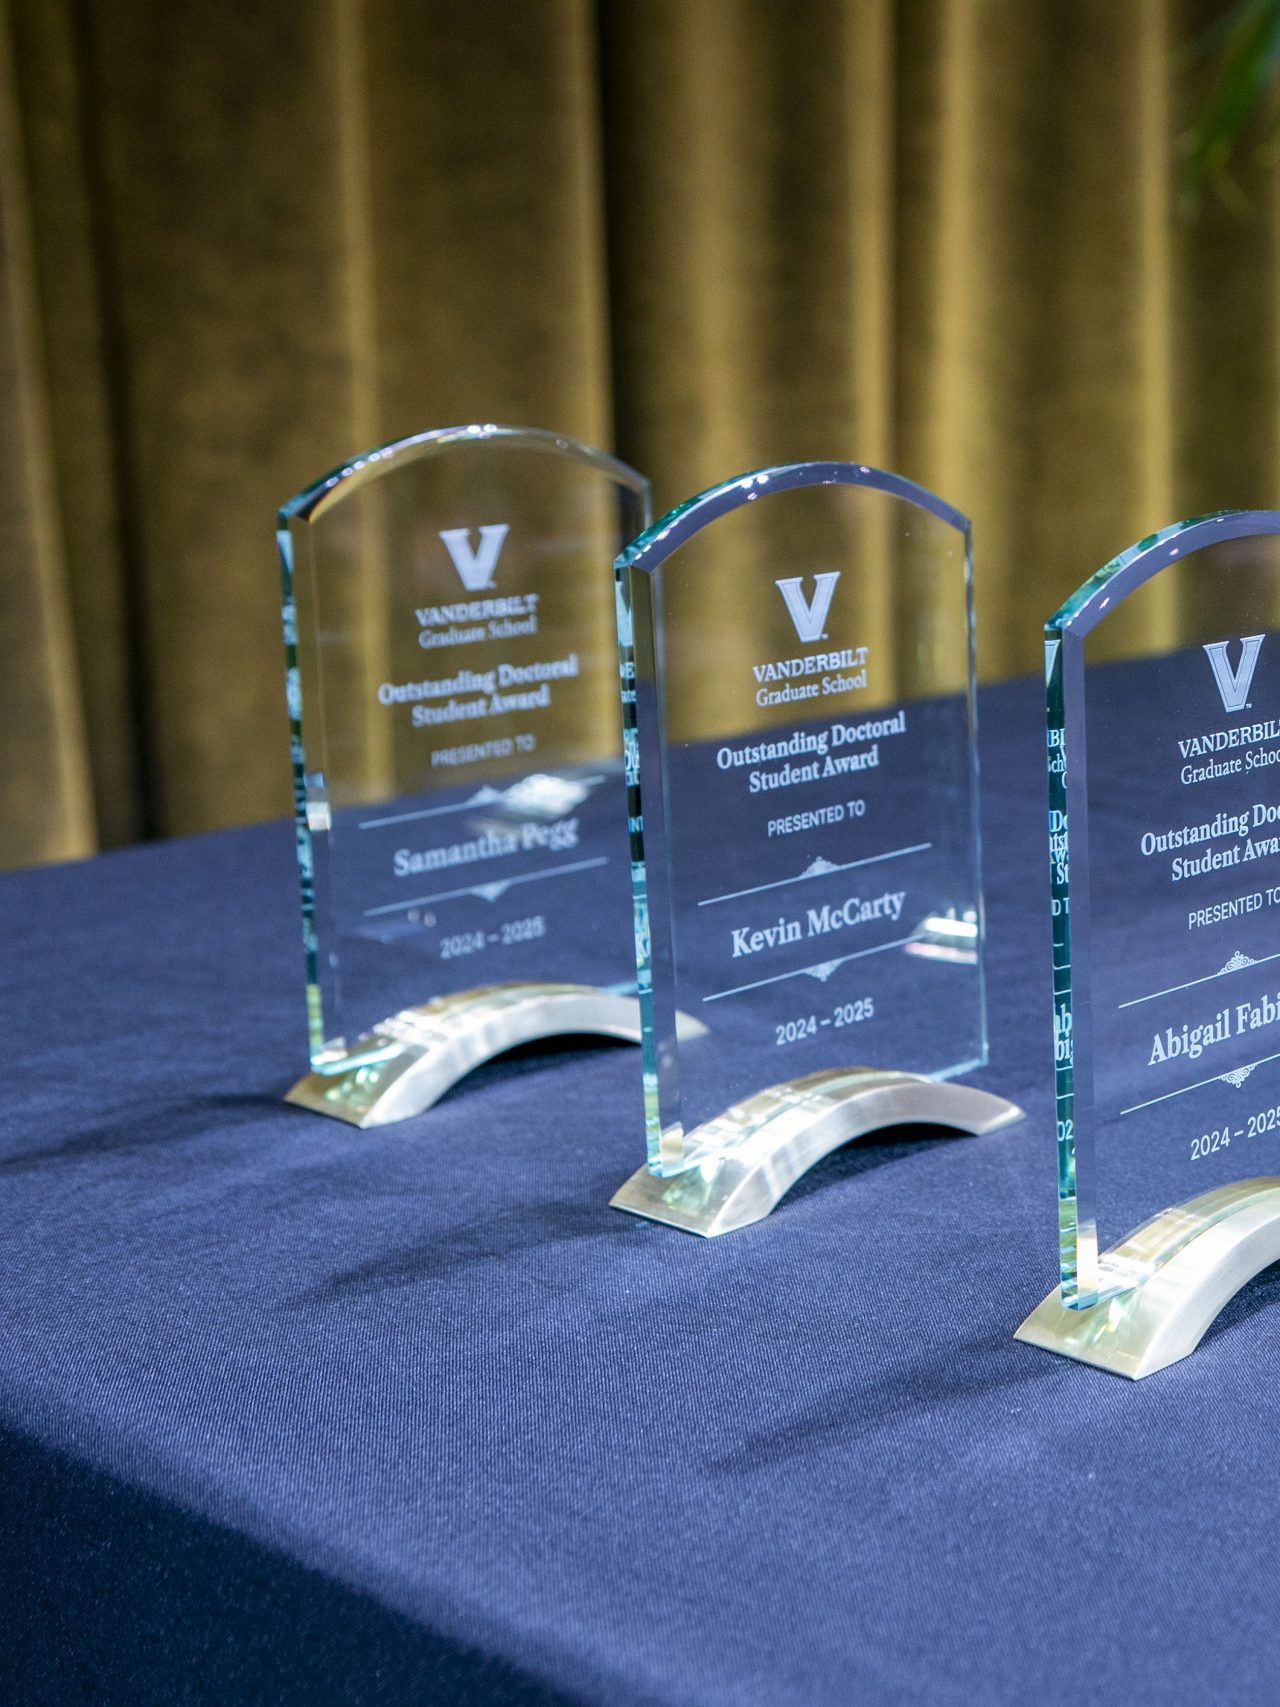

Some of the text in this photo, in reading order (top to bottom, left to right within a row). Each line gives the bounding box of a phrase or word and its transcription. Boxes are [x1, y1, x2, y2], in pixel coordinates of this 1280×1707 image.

[439, 524, 509, 591] V
[415, 594, 540, 628] VANDERBILT
[775, 571, 841, 643] V
[418, 614, 538, 649] Graduate School
[378, 653, 578, 705] Outstanding Doctoral
[753, 647, 868, 684] VANDERBILT
[756, 669, 867, 707] Graduate School
[1202, 634, 1266, 713] V
[411, 684, 551, 728] Student Award
[431, 734, 536, 768] PRESENTED TO
[717, 711, 906, 770] Outstanding Doctoral
[749, 744, 880, 794] Student Award
[1180, 758, 1242, 785] Graduate
[768, 800, 866, 837] PRESENTED TO
[1140, 811, 1249, 857] Outstanding
[394, 830, 519, 877] Samantha
[521, 816, 580, 852] Pegg
[1171, 848, 1240, 882] Student
[731, 891, 905, 958] Kevin McCarty
[1188, 895, 1263, 930] PRESENTED
[439, 930, 486, 960] 2024
[501, 915, 546, 945] 2025
[775, 1013, 817, 1046] 2024
[834, 998, 875, 1028] 2025
[1148, 1011, 1231, 1067] Abigail
[1191, 1126, 1230, 1161] 2024
